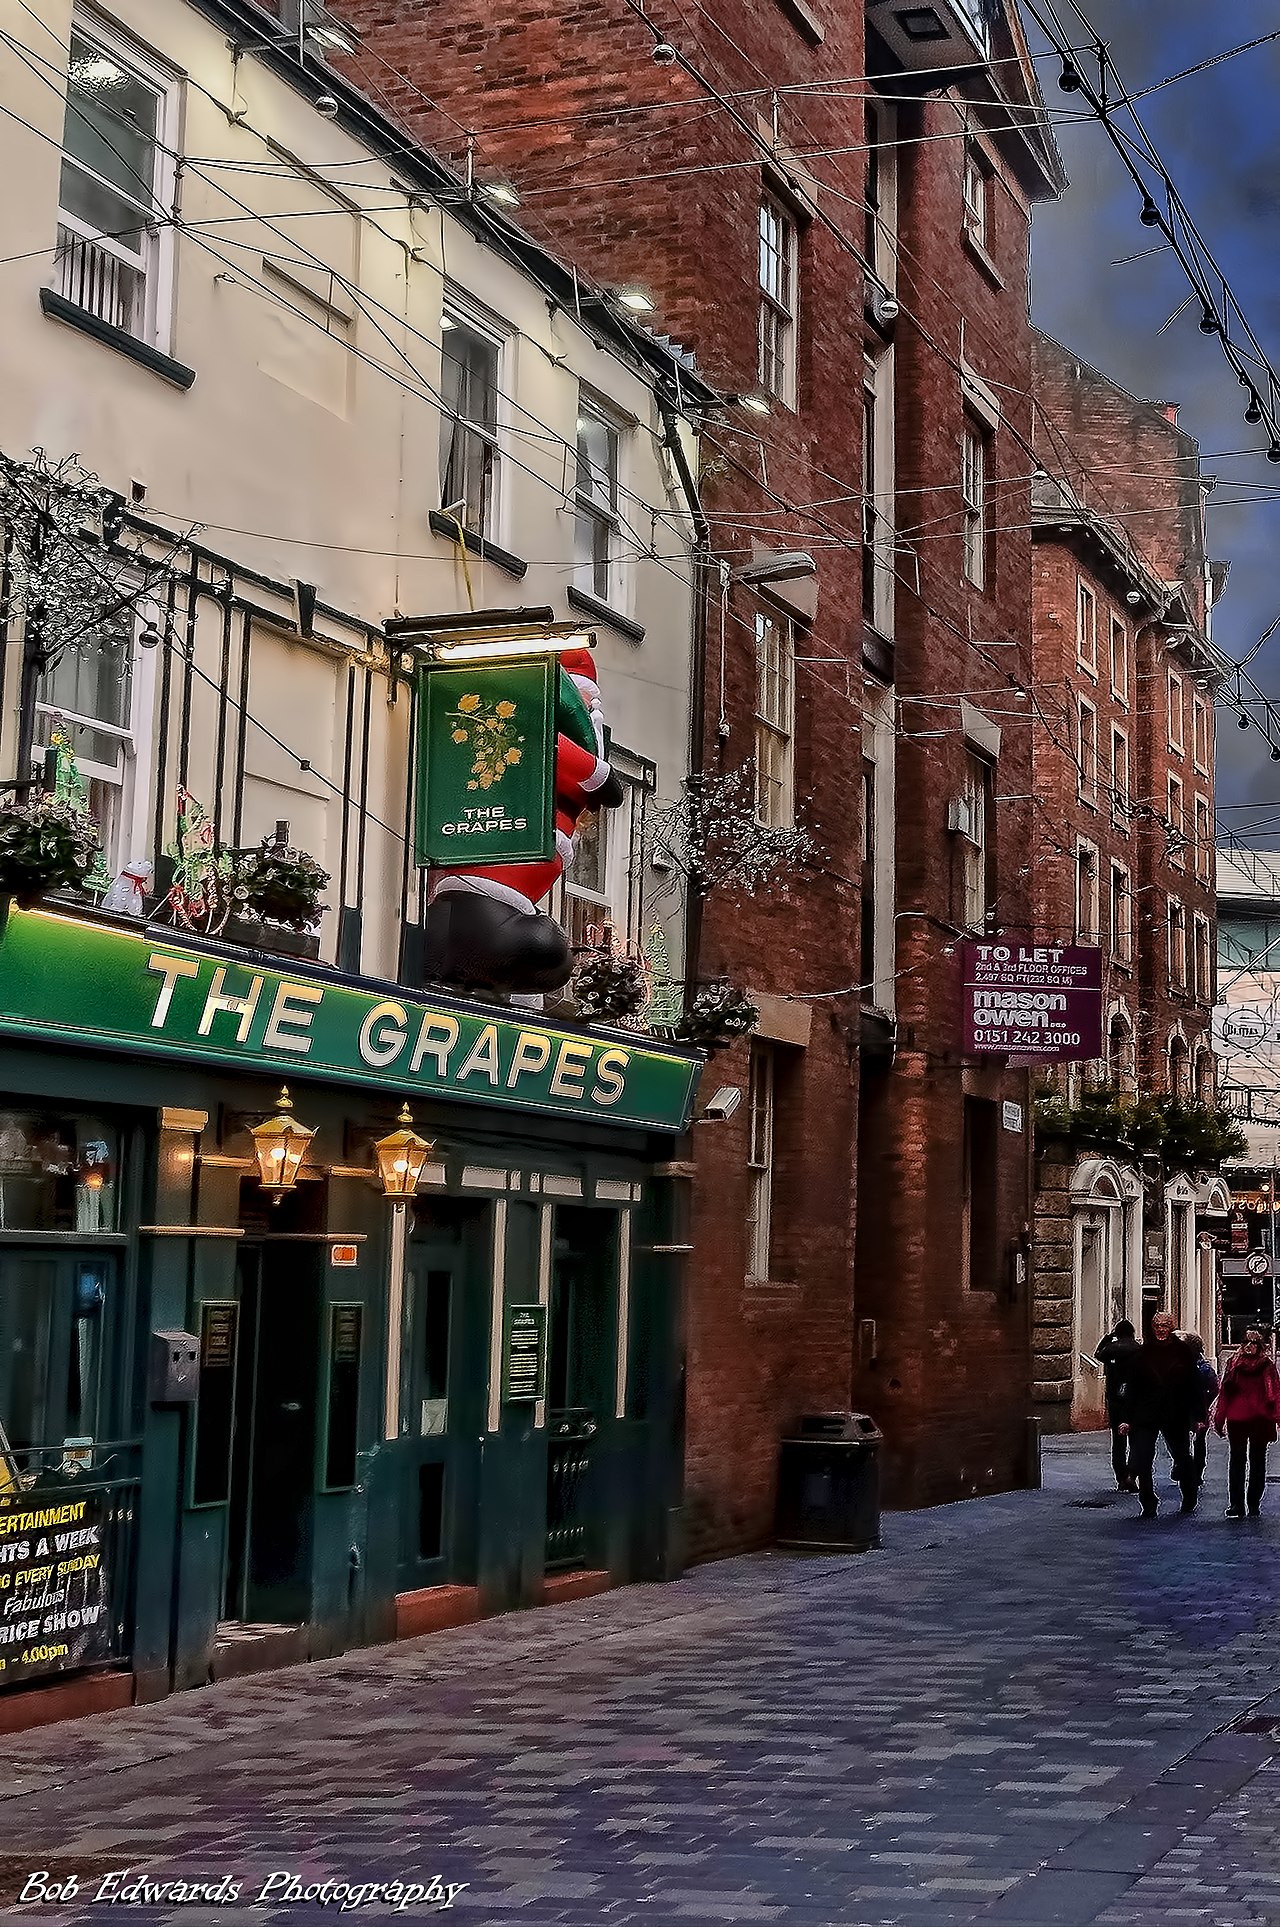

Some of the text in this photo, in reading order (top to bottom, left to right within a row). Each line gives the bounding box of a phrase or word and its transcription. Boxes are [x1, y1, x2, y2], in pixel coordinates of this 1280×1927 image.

[463, 806, 505, 819] THE
[441, 818, 527, 835] GRAPES
[976, 946, 1064, 963] TO LET
[1018, 963, 1049, 973] FLOOR
[1050, 965, 1088, 975] OFFICES
[1001, 973, 1014, 983] SQ
[1047, 975, 1060, 984] SQ
[973, 990, 1067, 1011] mason
[148, 953, 632, 1107] THE GRAPES
[974, 1029, 1081, 1045] 0151 242 3000
[35, 1537, 50, 1558] A
[54, 1525, 100, 1553] WEEK
[15, 1564, 55, 1586] EVERY
[57, 1553, 101, 1577] SUNDAY
[42, 1605, 101, 1633] SHOW
